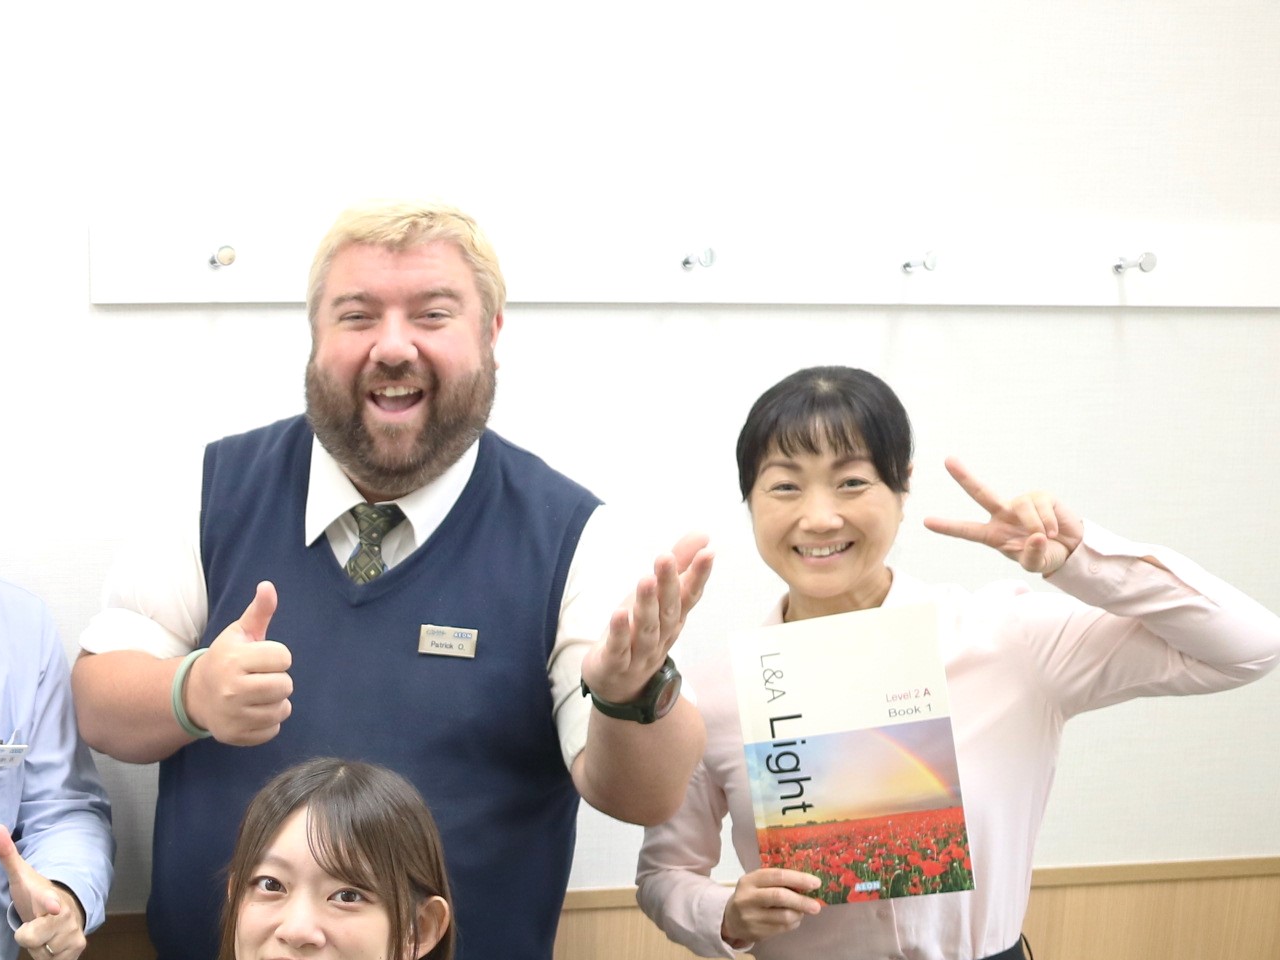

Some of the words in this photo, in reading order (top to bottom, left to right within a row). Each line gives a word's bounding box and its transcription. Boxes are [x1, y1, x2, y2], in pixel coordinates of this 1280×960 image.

[431, 640, 454, 649] Patrick
[760, 652, 786, 703] L&A
[886, 690, 912, 703] Level
[914, 689, 920, 699] 2
[923, 688, 931, 697] A
[888, 705, 922, 718] Book
[926, 702, 932, 712] 1
[766, 713, 814, 816] Light
